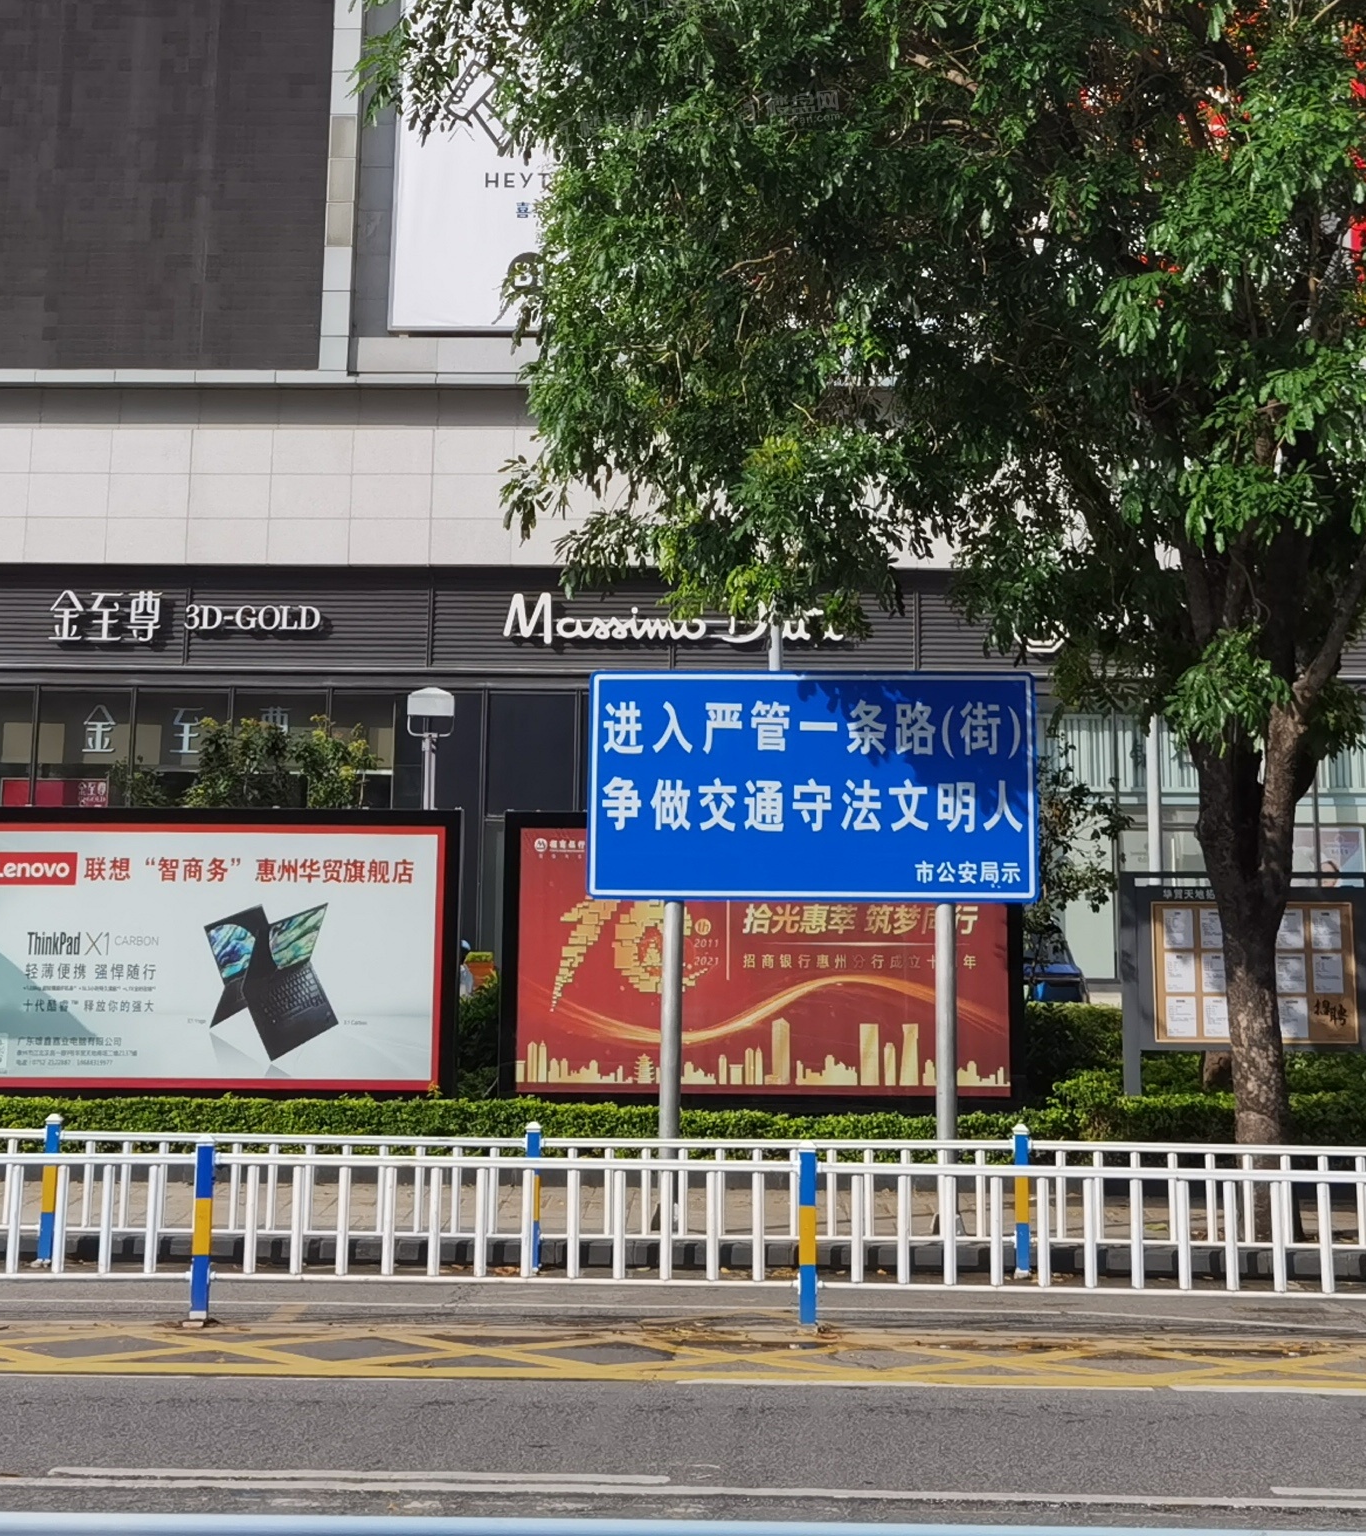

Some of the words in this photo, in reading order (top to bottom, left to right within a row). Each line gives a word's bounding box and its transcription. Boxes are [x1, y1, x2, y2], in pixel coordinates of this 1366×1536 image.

[48, 589, 164, 642] 金至尊
[184, 604, 321, 631] 3D-GOLD
[503, 592, 706, 645] Massimo
[601, 776, 1024, 833] 争做交通守法文明人
[84, 857, 131, 882] 联想
[255, 858, 415, 884] 惠州华贸旗舰店
[915, 861, 1022, 885] 市公安局示
[742, 903, 858, 935] 拾光惠萃
[27, 931, 81, 956] ThinkPad
[84, 931, 111, 956] X1
[114, 935, 160, 947] CARBON
[25, 963, 87, 981] 轻薄便携
[94, 963, 158, 981] 强悍随行
[742, 953, 977, 970] 招商银行惠州分行成立十年
[84, 998, 155, 1013] 释放你的强大
